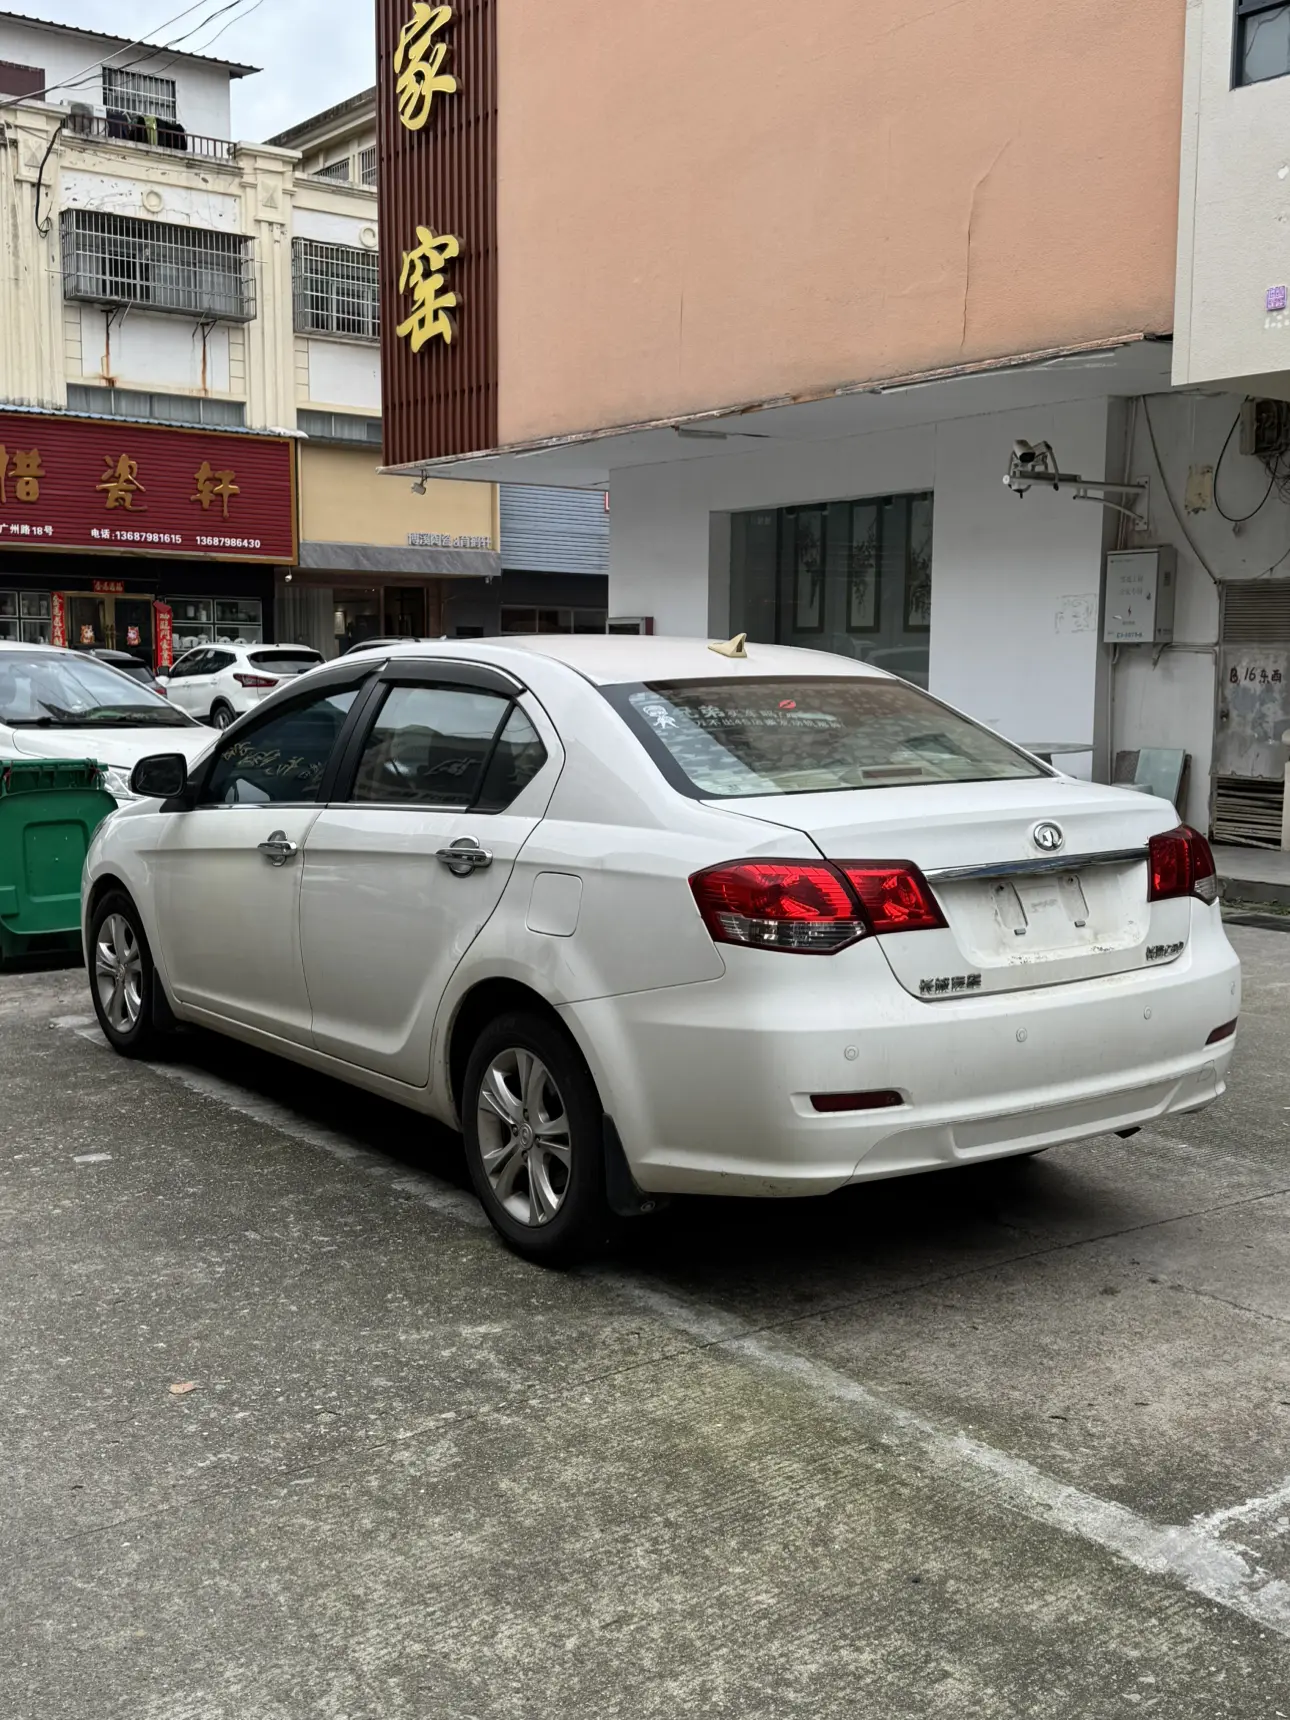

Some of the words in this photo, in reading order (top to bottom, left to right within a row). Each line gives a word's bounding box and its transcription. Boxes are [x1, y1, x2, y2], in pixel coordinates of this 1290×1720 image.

[394, 2, 459, 352] 家窑
[0, 523, 54, 536] 广州路18号
[195, 536, 261, 548] 13687986430
